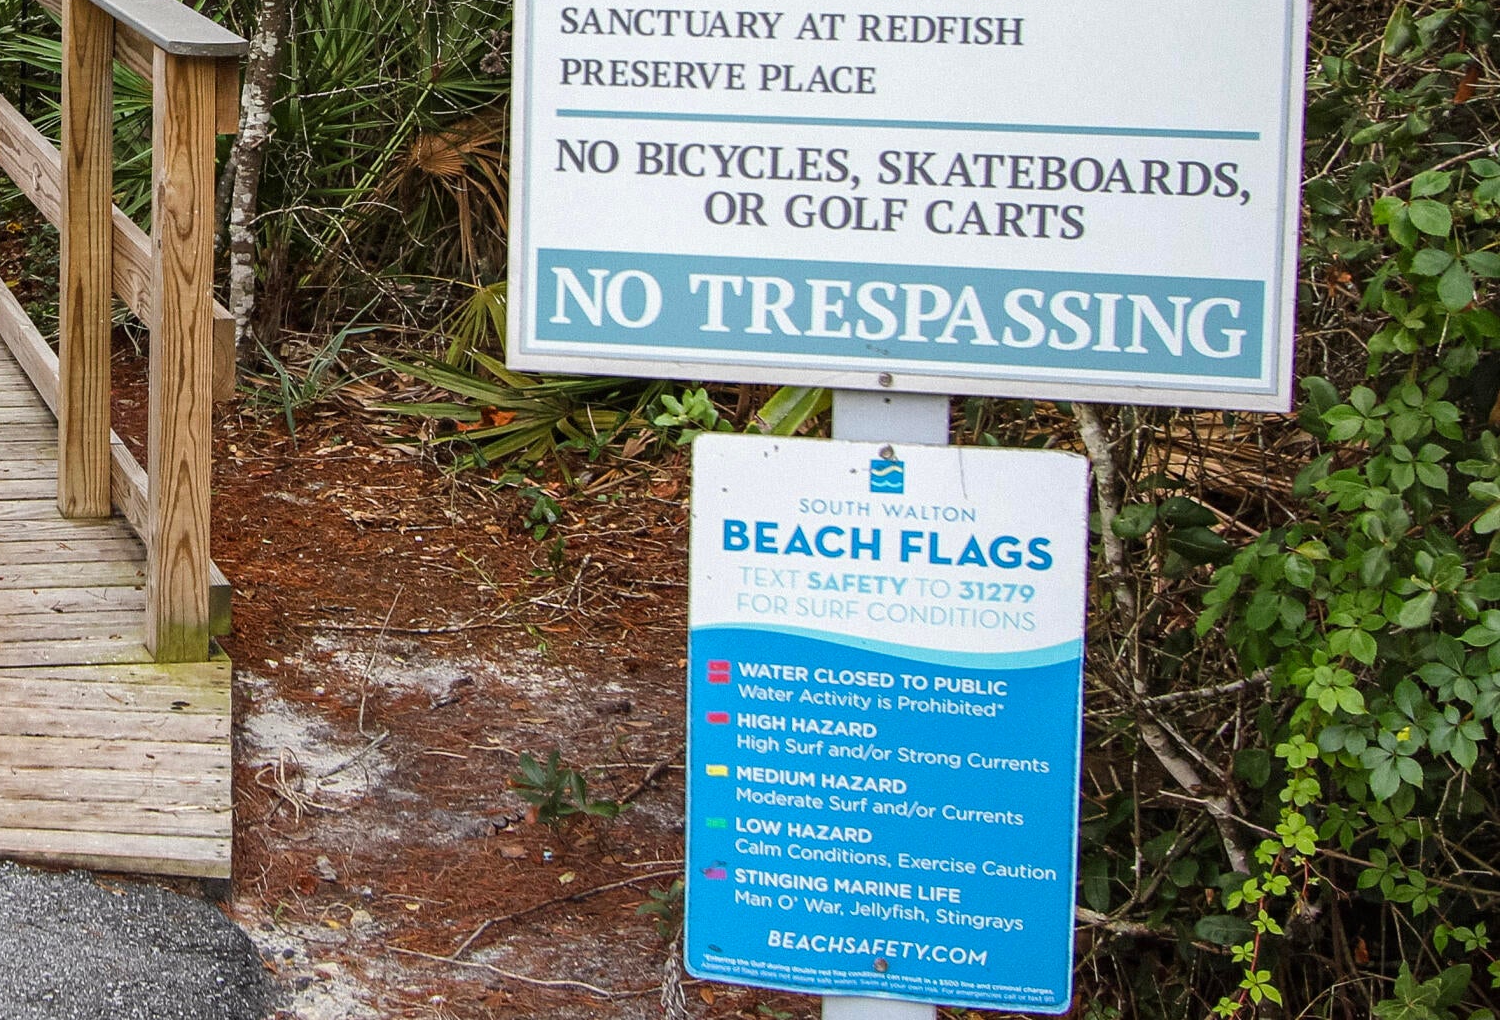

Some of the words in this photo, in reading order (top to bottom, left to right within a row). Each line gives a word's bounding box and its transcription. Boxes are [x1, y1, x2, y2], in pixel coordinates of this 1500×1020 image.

[560, 6, 783, 39] SANCTUARY
[795, 12, 845, 40] AT
[857, 14, 1024, 45] REDFISH
[560, 58, 745, 90] PRESERVE
[759, 63, 875, 94] PLACE
[555, 138, 619, 173] NO
[635, 141, 860, 190] BICYCLES,
[878, 150, 1250, 205] SKATEBOARDS,
[704, 190, 767, 226] OR
[784, 194, 907, 231] GOLF
[925, 199, 1084, 240] CARTS
[549, 266, 662, 328] NO
[688, 273, 1246, 358] TRESPASSING
[799, 497, 869, 516] SOUTH
[881, 503, 975, 522] WALTON
[722, 518, 880, 560] BEACH
[900, 529, 1053, 571] FLAGS
[740, 566, 800, 589] TEXT
[808, 571, 908, 598] SAFETY
[915, 578, 951, 599] TO
[958, 580, 1036, 604] 31279
[737, 592, 787, 614] FOR
[795, 596, 858, 619] SURF
[866, 601, 1036, 632] CONDITIONS
[737, 661, 808, 682] WATER
[813, 667, 894, 688] CLOSED
[899, 673, 928, 690] TO
[934, 676, 1007, 696] PUBLIC
[737, 683, 794, 701] Water
[798, 688, 871, 710] Activity
[877, 694, 892, 709] is
[737, 712, 785, 731] HIGH
[791, 717, 877, 738] HAZARD
[736, 733, 779, 753] High
[784, 737, 823, 755] Surf
[827, 743, 892, 760] and/or
[897, 746, 961, 769] Strong
[966, 752, 1049, 773] Currents
[736, 765, 815, 787] MEDIUM
[821, 773, 907, 794] HAZARD
[735, 786, 823, 809] Moderate
[828, 795, 867, 812] Surf
[872, 801, 936, 818] and/or
[941, 804, 1023, 825] Currents
[735, 816, 782, 835] LOW
[787, 822, 872, 843] HAZARD
[734, 838, 782, 857] Calm
[786, 843, 891, 867] Conditions,
[897, 852, 976, 874] Exercise
[981, 860, 1056, 880] Caution
[734, 868, 828, 892] STINGING
[834, 878, 911, 899] MARINE
[917, 885, 960, 903] LIFE
[734, 889, 772, 907] Man
[803, 897, 843, 915] War,
[849, 900, 929, 923] Jellyfish,
[935, 908, 1023, 932] Stingrays
[767, 929, 987, 965] BEACHSAFETY.COM
